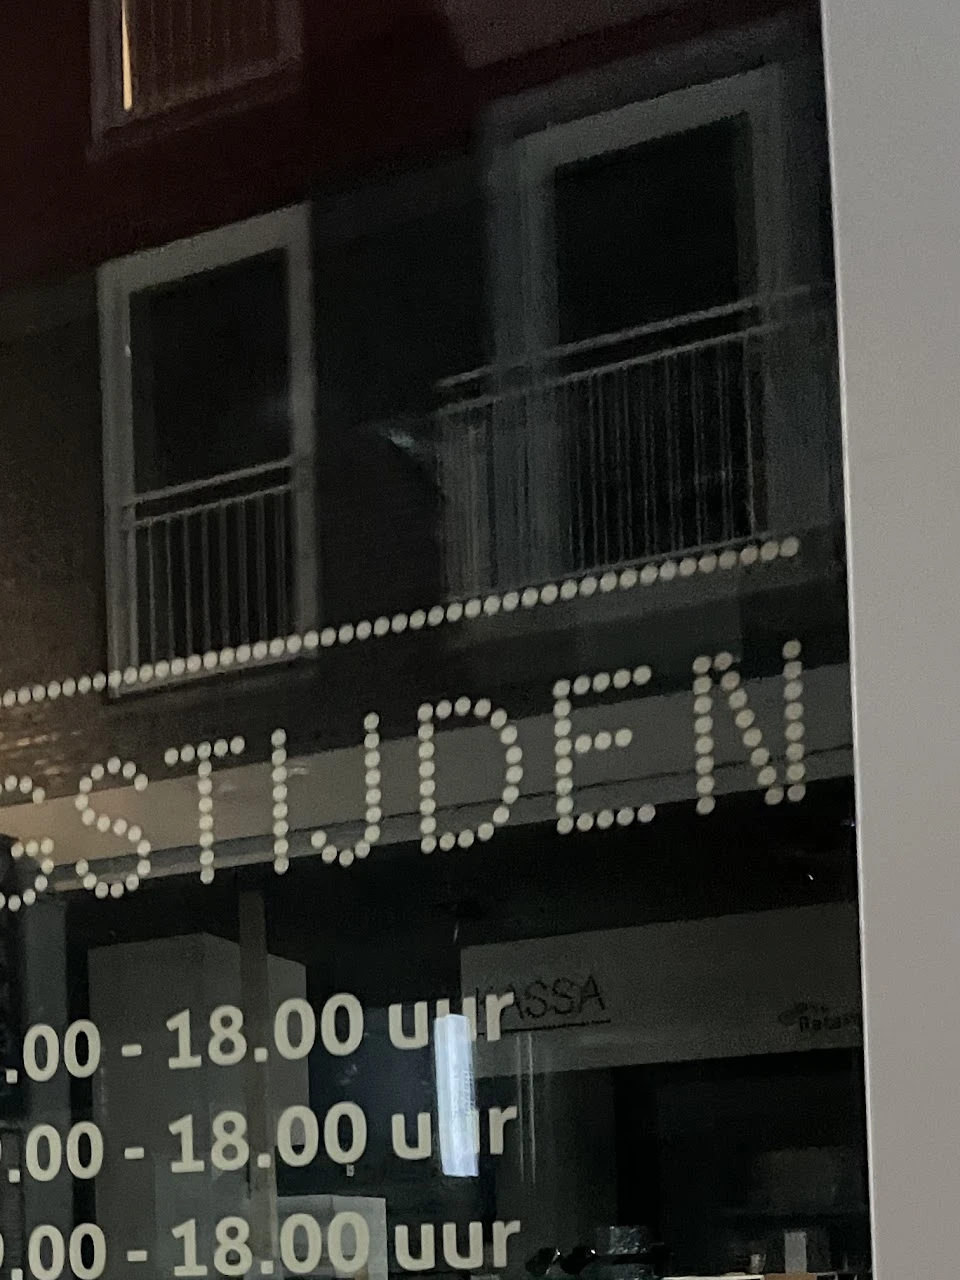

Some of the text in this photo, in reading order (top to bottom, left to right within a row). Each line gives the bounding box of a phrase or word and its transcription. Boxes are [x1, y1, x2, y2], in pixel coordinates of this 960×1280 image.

[121, 1043, 143, 1057] -
[166, 992, 364, 1070] 18.00
[123, 1148, 146, 1160] -
[168, 1101, 367, 1175] 18.00
[392, 1104, 518, 1162] ur
[126, 1249, 148, 1261] -
[171, 1211, 371, 1279] 18.00
[394, 1219, 522, 1272] uur
